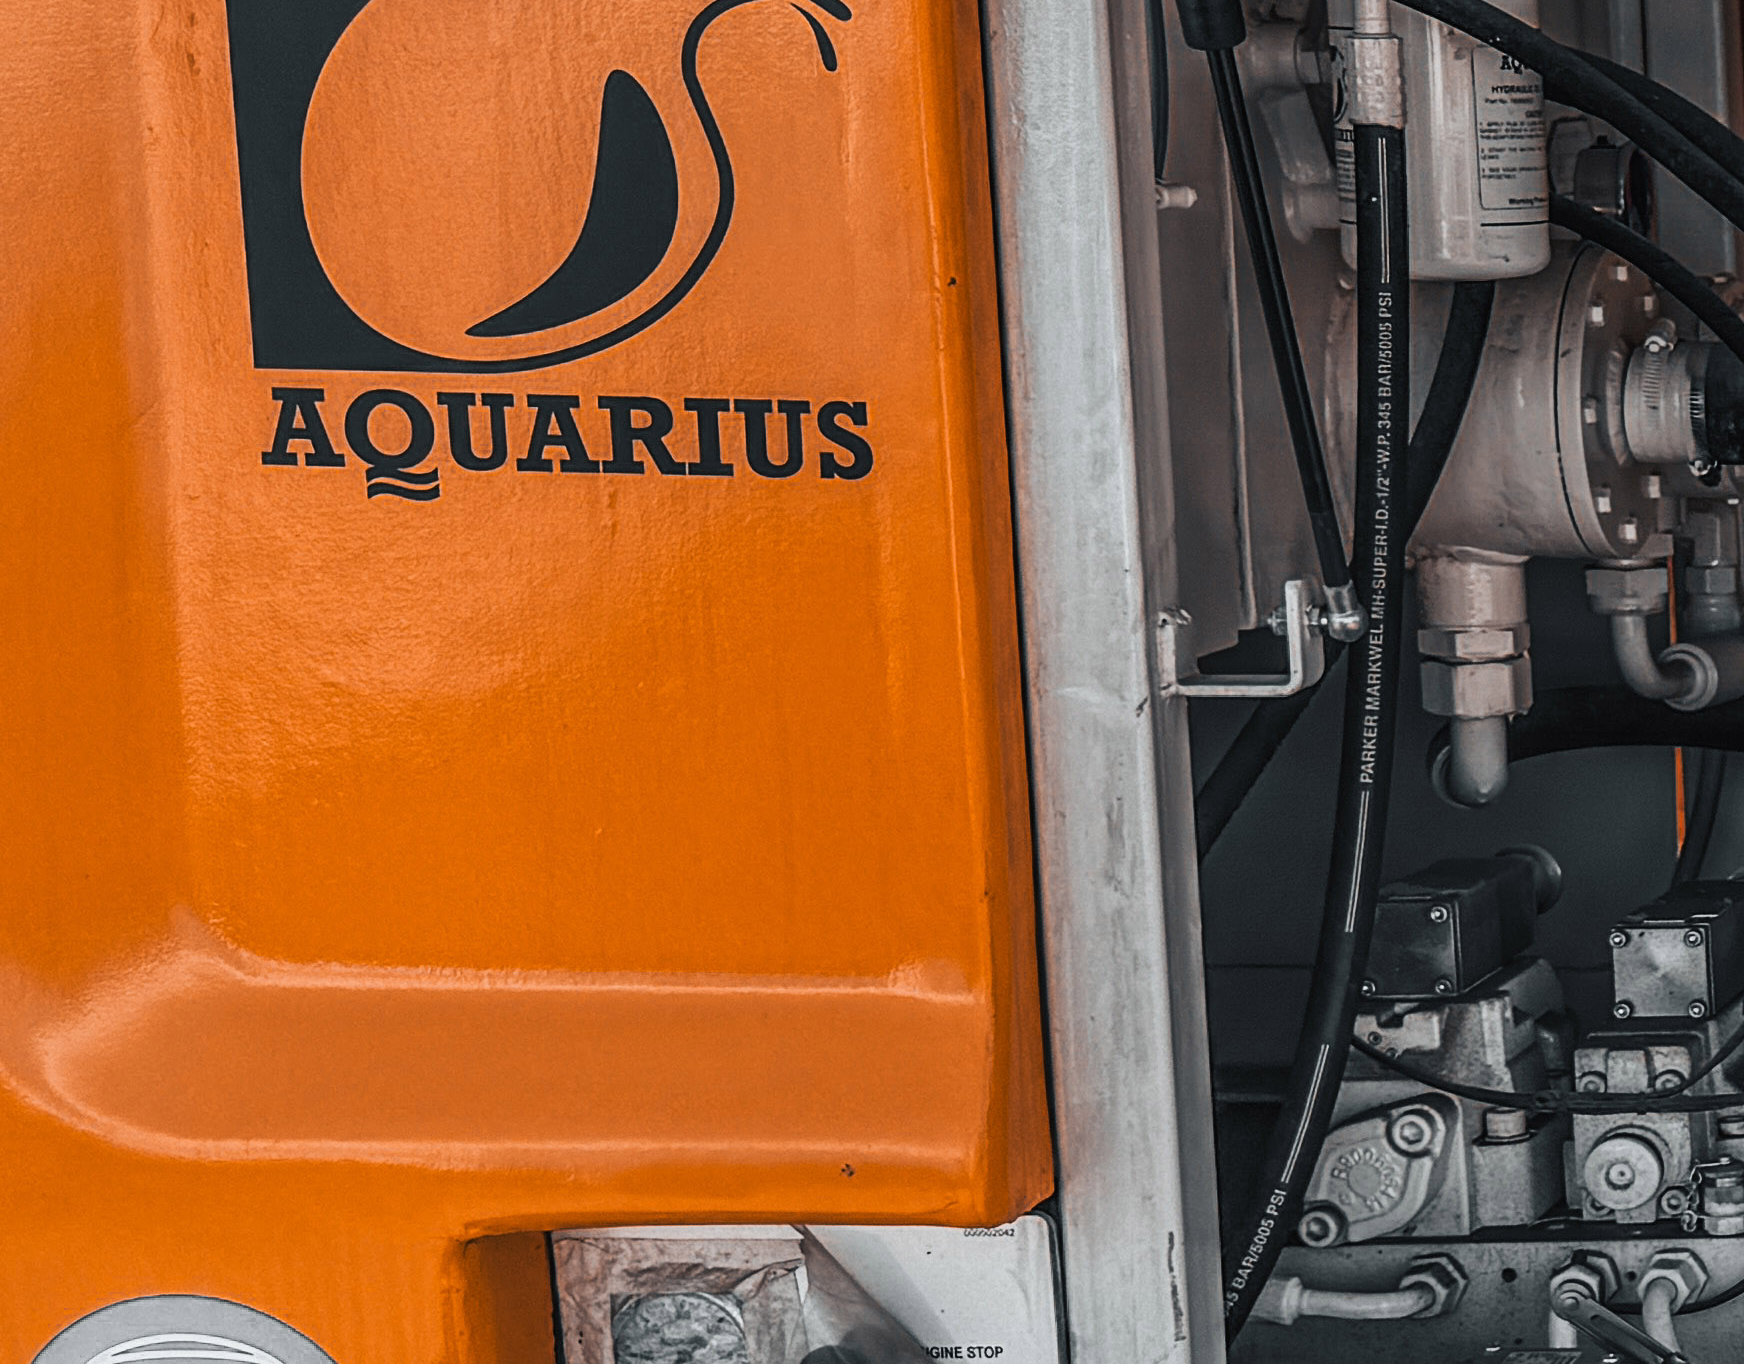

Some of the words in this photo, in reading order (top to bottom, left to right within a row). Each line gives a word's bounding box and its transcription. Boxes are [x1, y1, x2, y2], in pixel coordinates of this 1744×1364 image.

[1378, 292, 1392, 318] PSI
[261, 386, 875, 501] AQUARIUS
[1378, 402, 1391, 429] 345
[1365, 624, 1383, 710] MARKWEL
[1360, 715, 1378, 784] PARKER
[1232, 1218, 1275, 1289] BAR/5005
[1266, 1189, 1287, 1216] PSI
[967, 1346, 1004, 1359] STOP
